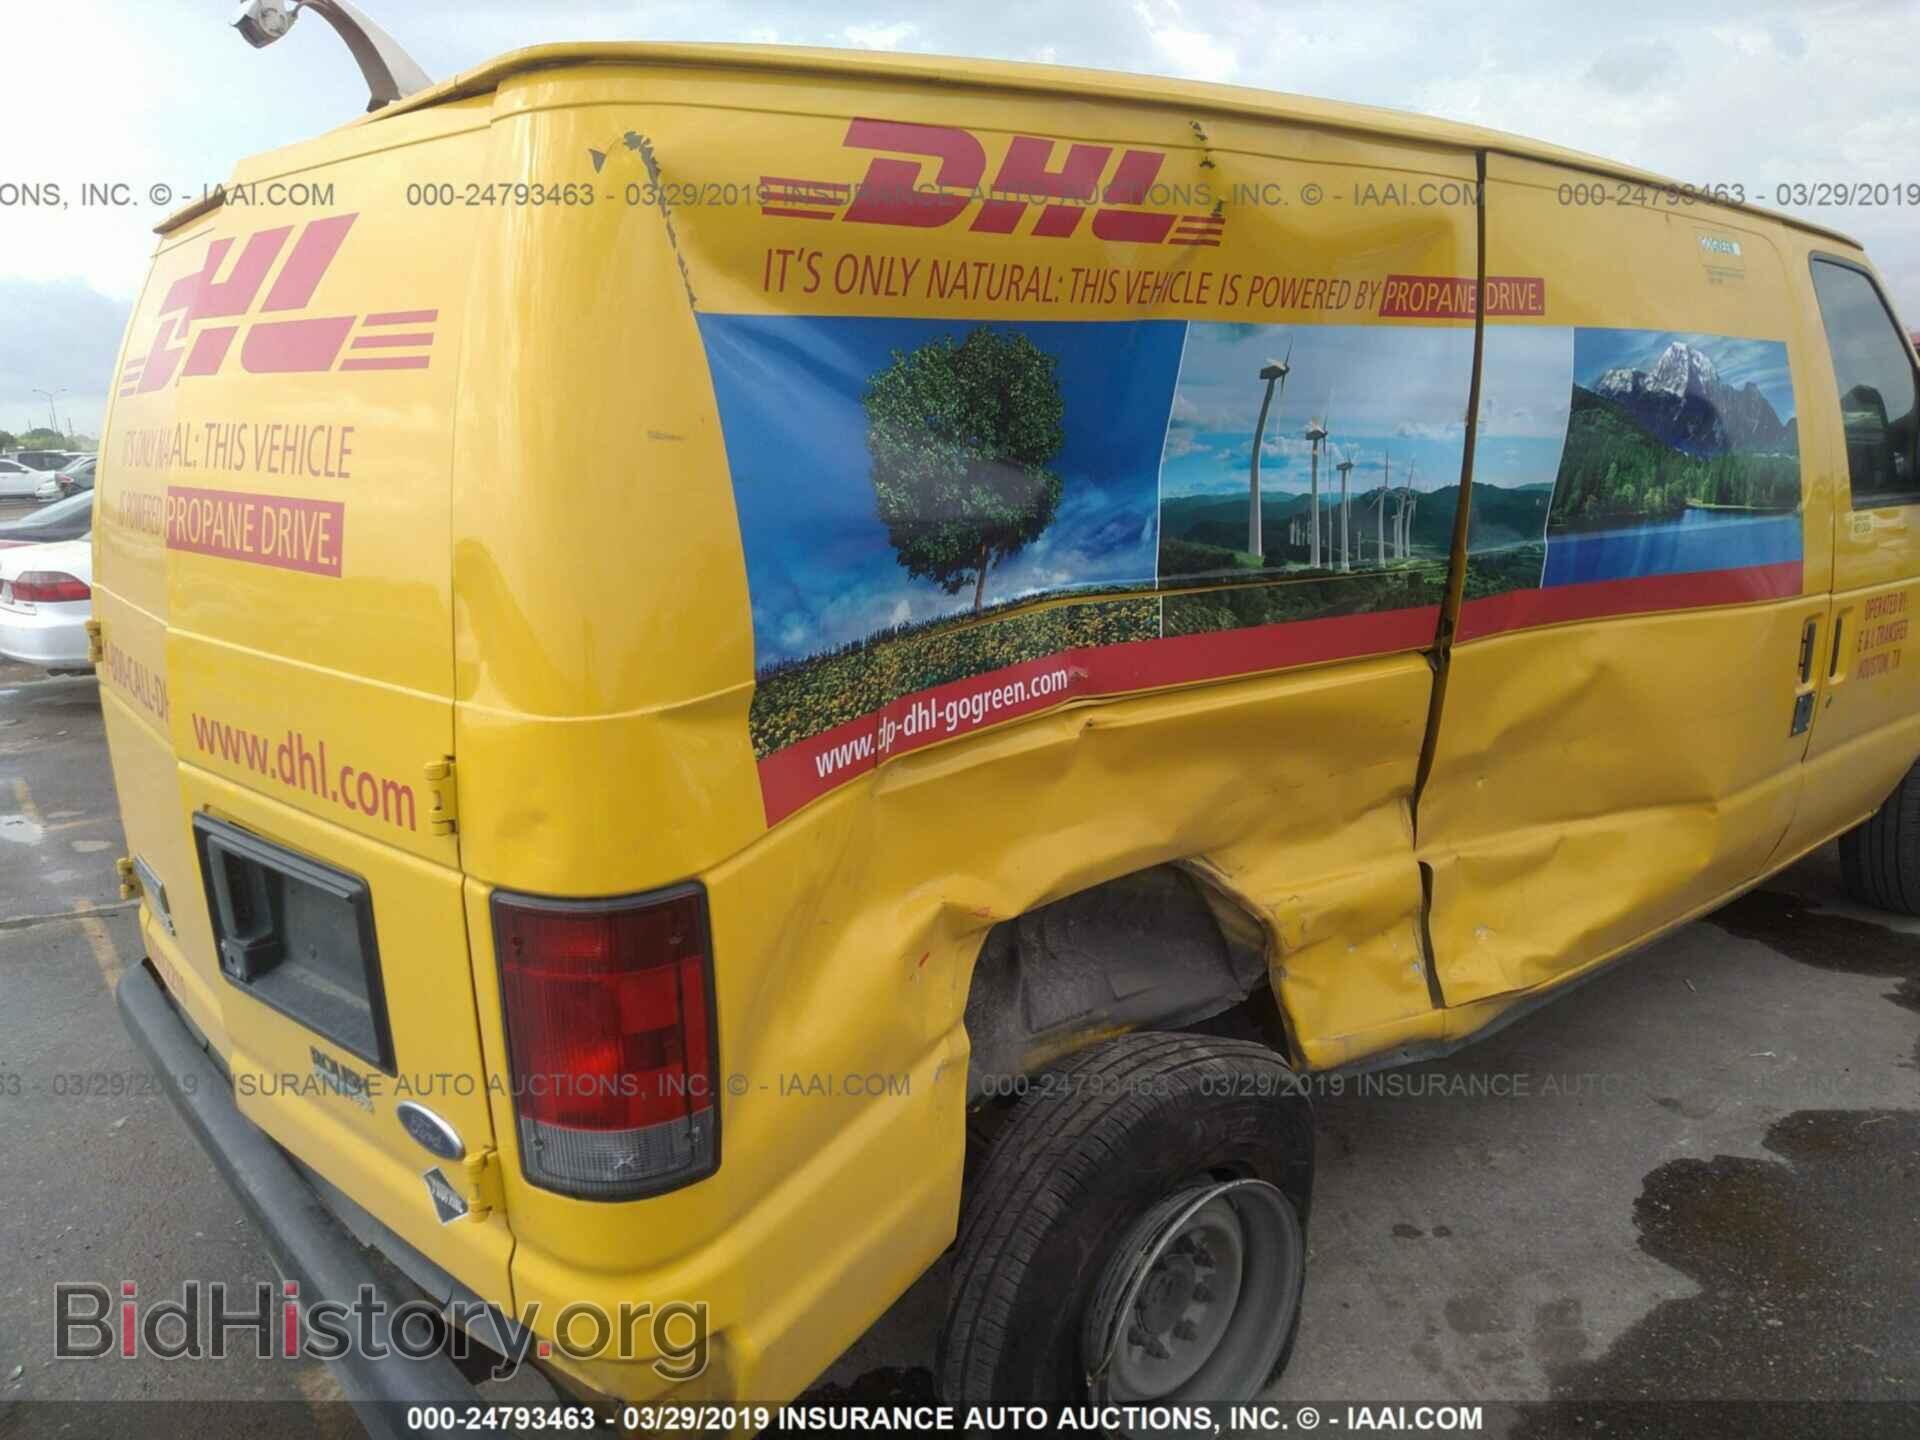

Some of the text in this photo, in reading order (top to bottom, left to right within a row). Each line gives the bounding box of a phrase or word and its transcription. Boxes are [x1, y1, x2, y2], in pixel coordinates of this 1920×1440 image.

[842, 117, 1178, 244] DHL
[763, 248, 1544, 314] IT'S ONLY NATURAL: THIS VEHICLE IS POWERED BY PROPANE DRIVE.
[205, 423, 248, 471] THIS
[254, 424, 355, 479] VEHICLE
[166, 494, 255, 554] PROPANE
[260, 504, 338, 567] DRIVE.
[815, 666, 1068, 779] www.dp-dhl-gogreen.com
[192, 711, 416, 832] www.dhl.com
